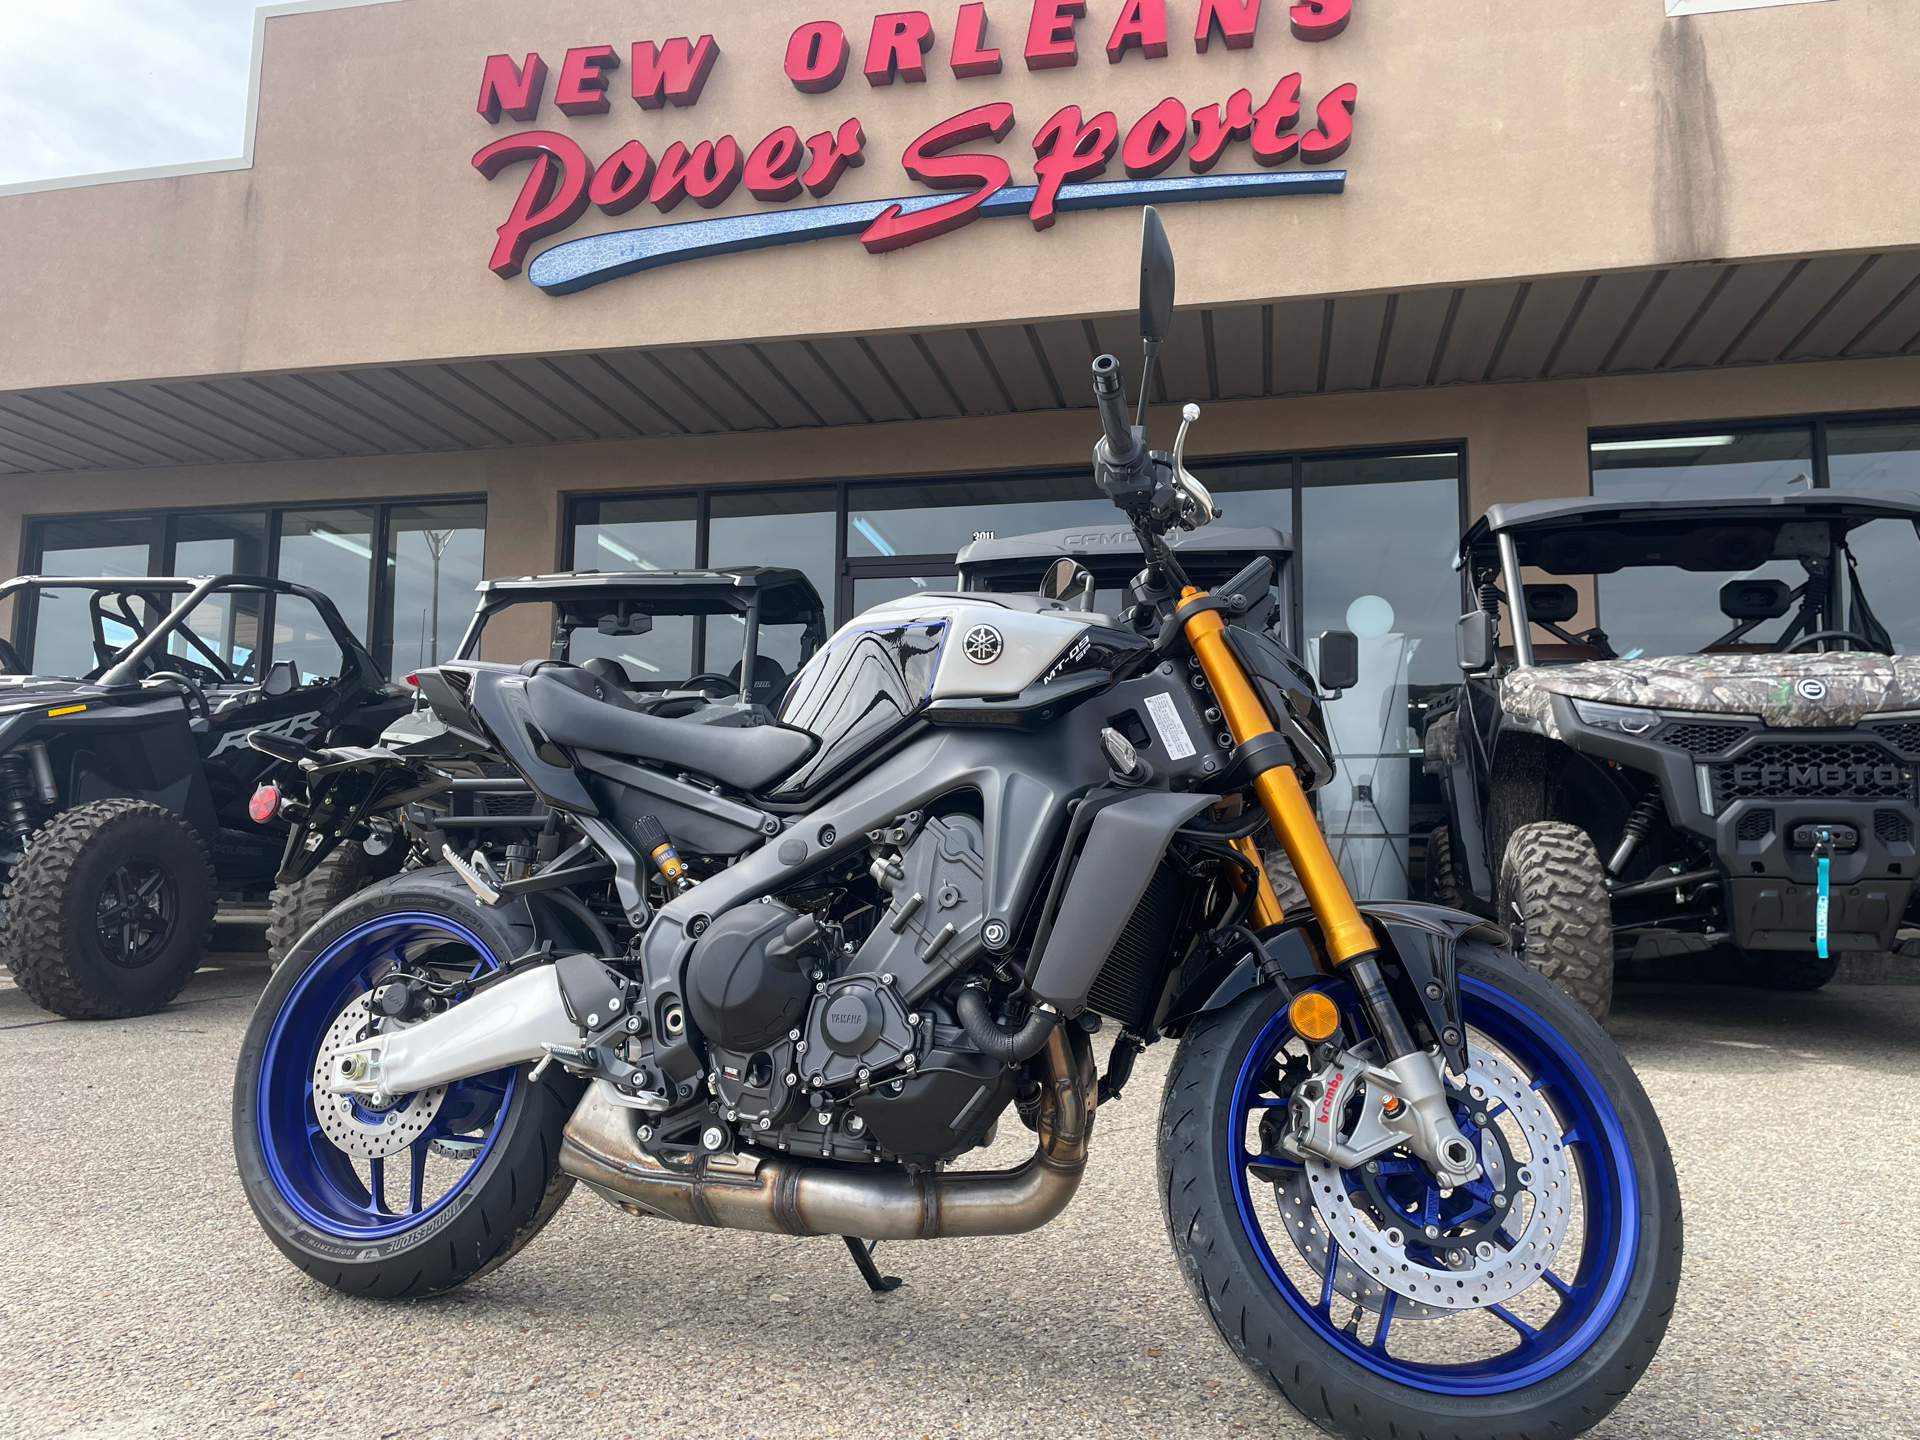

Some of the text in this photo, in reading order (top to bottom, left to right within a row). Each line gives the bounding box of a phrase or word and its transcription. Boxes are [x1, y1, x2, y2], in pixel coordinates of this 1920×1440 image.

[476, 34, 720, 124] NEW
[471, 72, 1358, 280] Power Sports
[1063, 532, 1179, 546] CFMOO
[1043, 635, 1090, 685] MT-09
[1075, 643, 1091, 662] SP
[207, 710, 321, 758] RZR
[1733, 765, 1899, 786] CFMOTO
[212, 844, 263, 856] POLARIS
[1817, 895, 1829, 939] CFMOTO
[831, 1013, 862, 1025] YAMAHA
[1316, 1072, 1344, 1124] brembo
[386, 1199, 463, 1253] BRIDGESTONE
